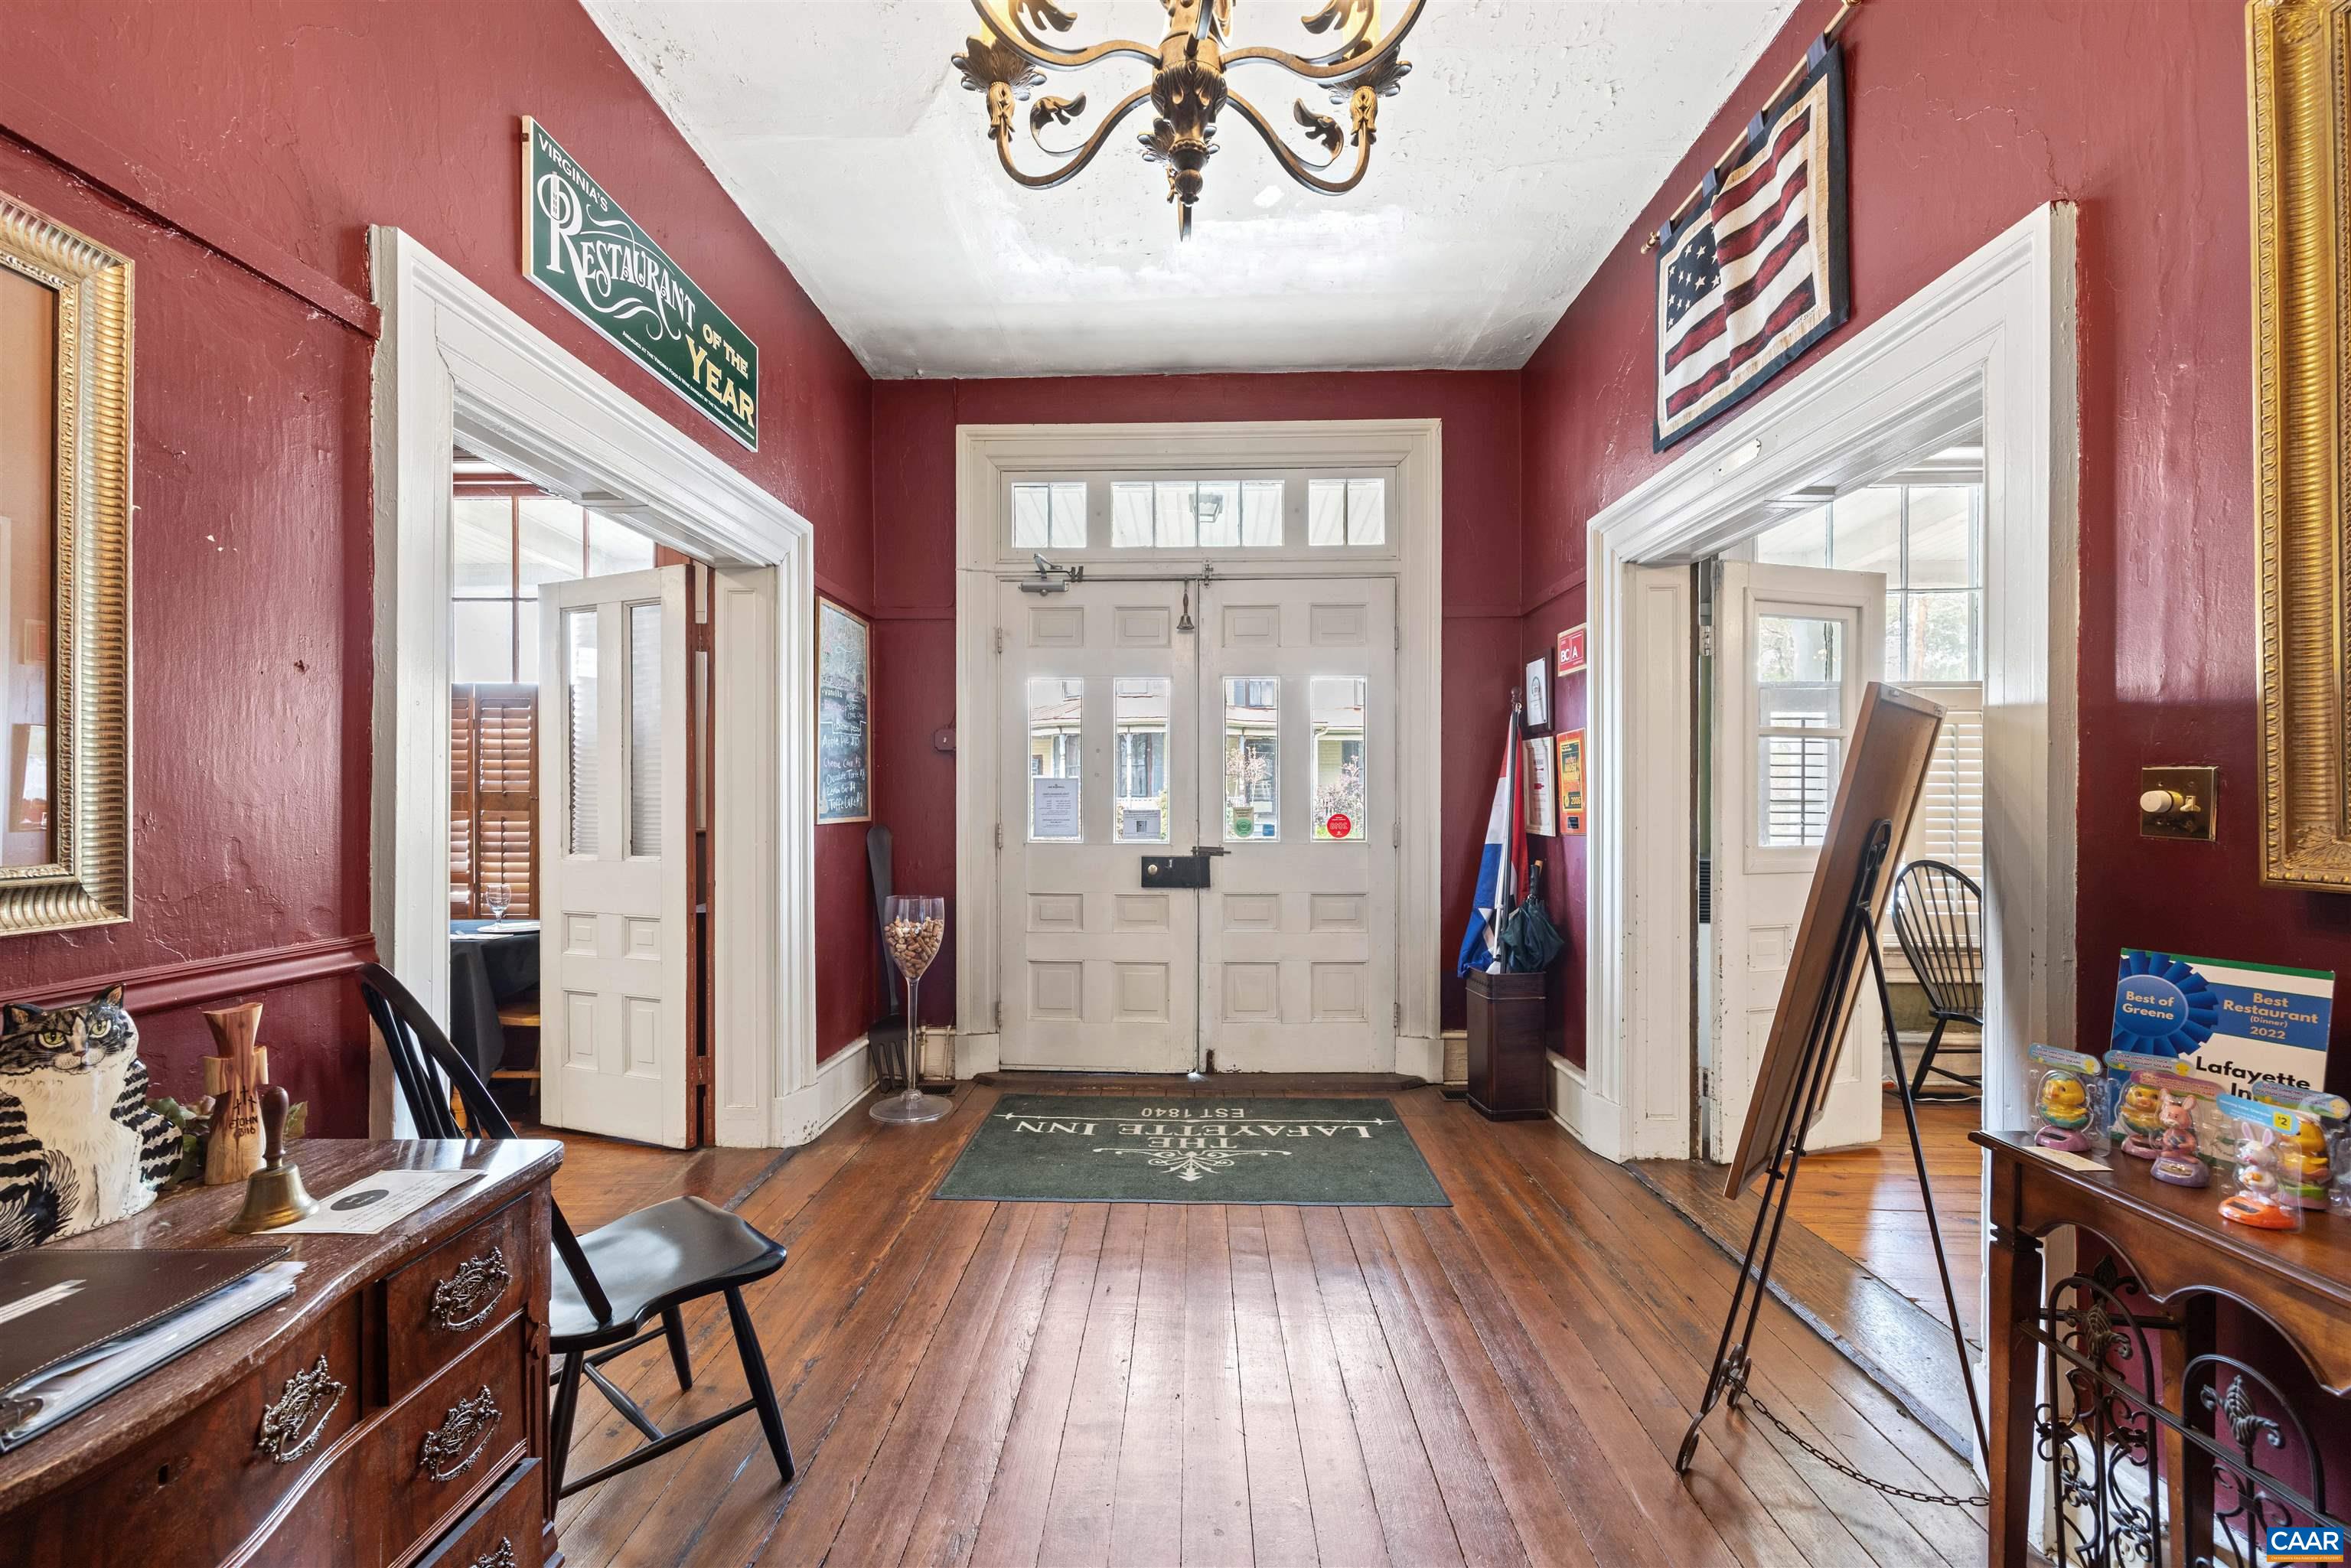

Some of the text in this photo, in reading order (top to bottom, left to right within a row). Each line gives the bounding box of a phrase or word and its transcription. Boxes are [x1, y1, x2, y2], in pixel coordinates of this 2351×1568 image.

[538, 132, 608, 212] VIRGINIA'S
[536, 171, 696, 340] RESTAURANT
[703, 323, 748, 380] OF THE
[685, 334, 755, 429] YEAR
[821, 734, 839, 749] Apple
[2125, 990, 2175, 1007] Best of
[2252, 993, 2289, 1007] Best
[2121, 1002, 2174, 1020] Greene
[2223, 999, 2318, 1024] Restaurant
[2250, 1015, 2288, 1028] (Dinner)
[2249, 1026, 2286, 1040] 2022
[2196, 1055, 2311, 1090] Lafayette
[2230, 1082, 2256, 1101] In
[1141, 1107, 1244, 1118] EST 1840
[2278, 1116, 2287, 1126] $2
[229, 1116, 258, 1130] JOHN
[238, 1126, 256, 1137] 3:16
[1012, 1120, 1374, 1139] LAFAYETTE INN
[1148, 1136, 1237, 1149] THE
